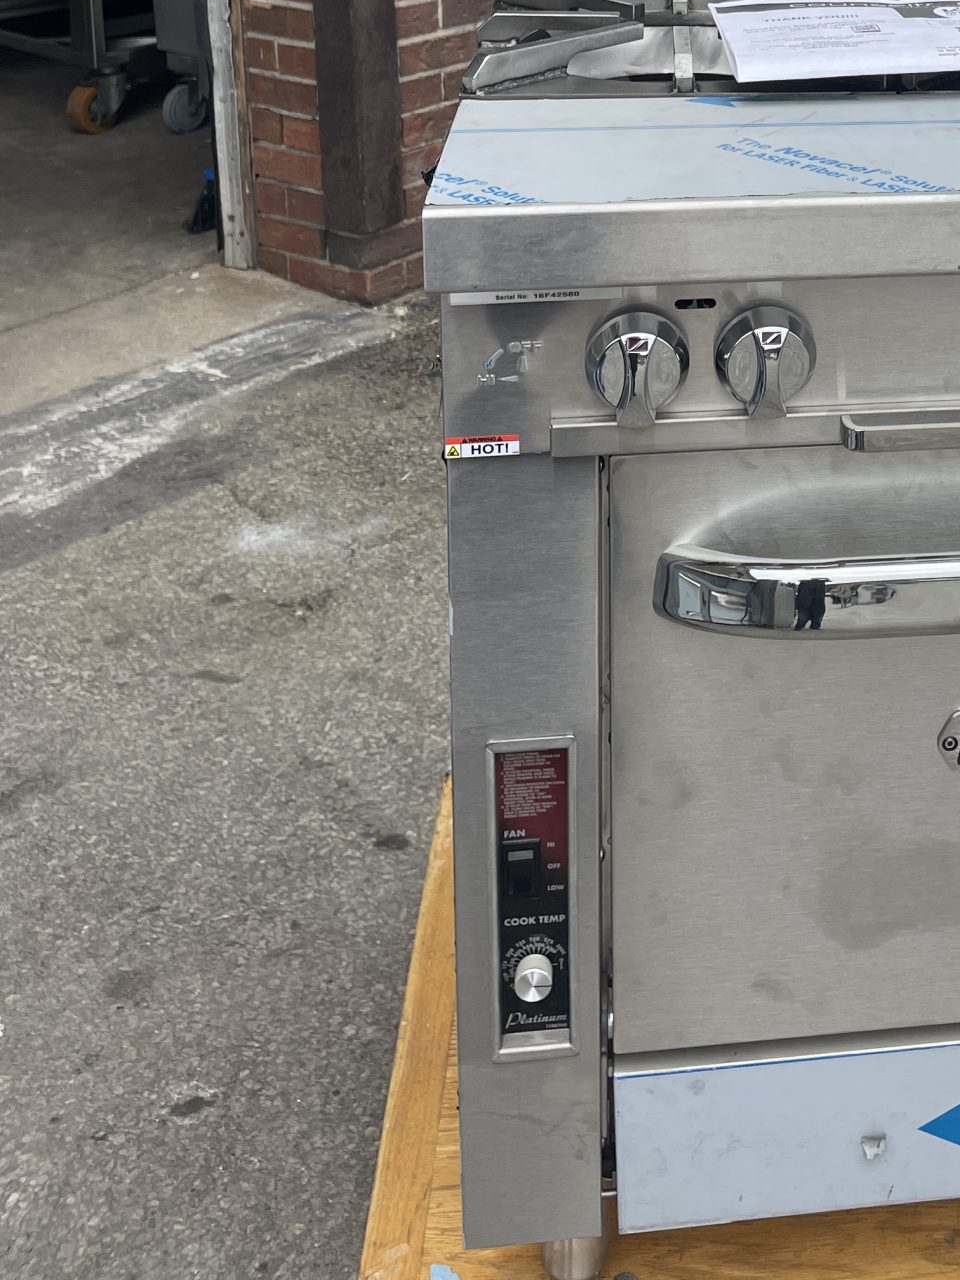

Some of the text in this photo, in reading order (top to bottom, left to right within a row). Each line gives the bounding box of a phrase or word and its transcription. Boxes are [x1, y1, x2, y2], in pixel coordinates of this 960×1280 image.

[736, 137, 772, 150] The
[716, 142, 745, 154] for
[743, 149, 801, 167] LASER
[800, 164, 848, 181] Fiber
[471, 443, 509, 455] HOT!
[503, 829, 526, 838] FAN
[504, 914, 566, 927] COOK TEMP
[505, 1012, 567, 1029] Platinum
